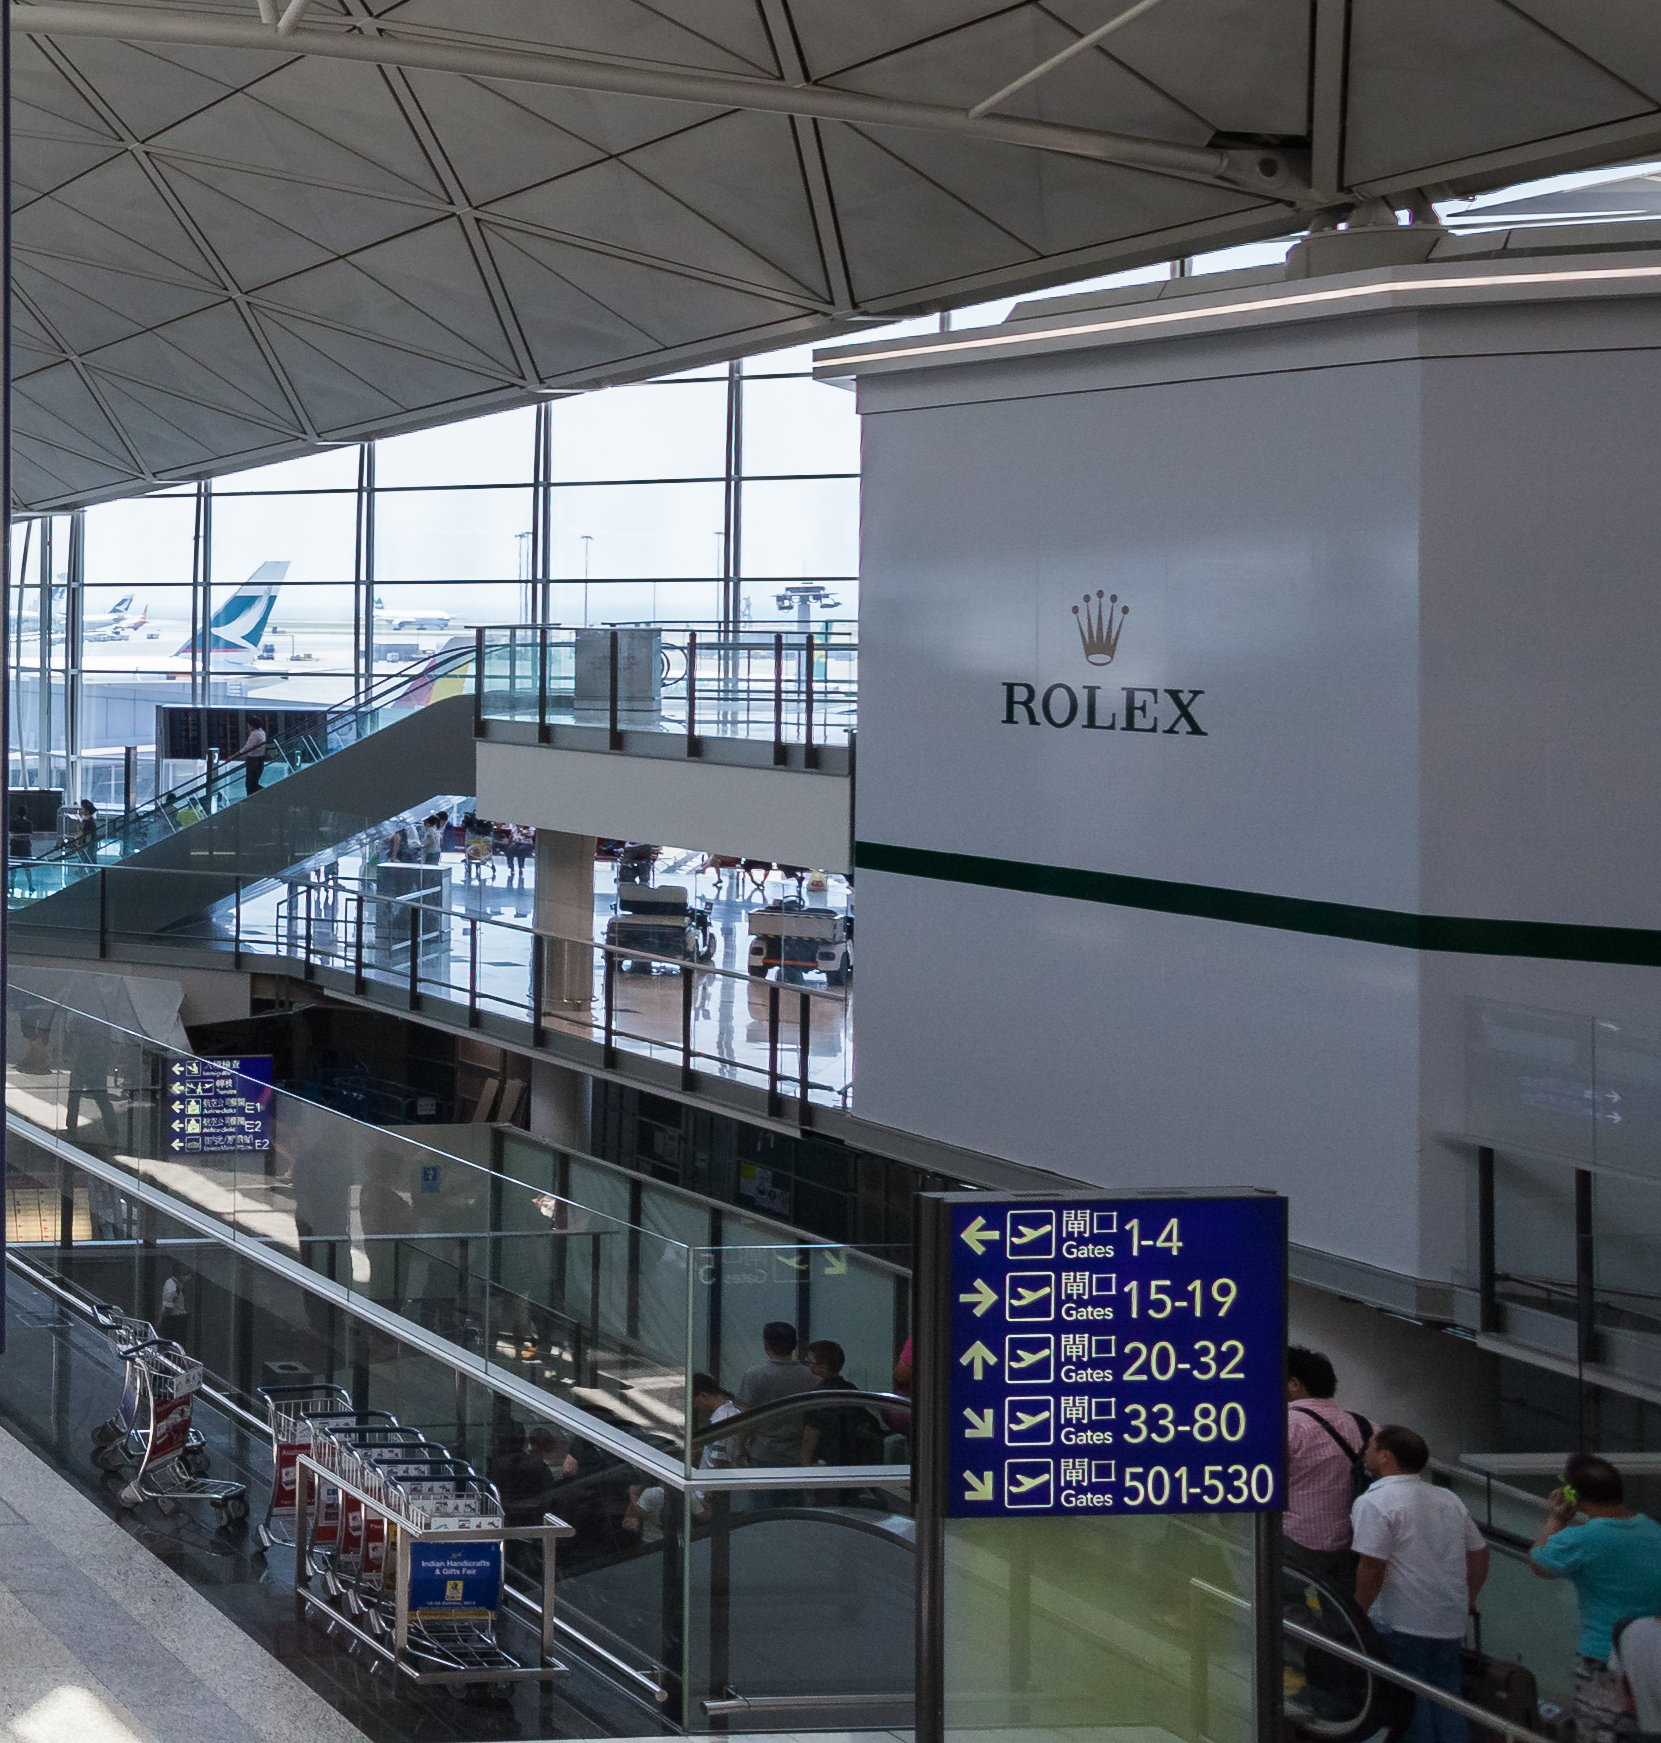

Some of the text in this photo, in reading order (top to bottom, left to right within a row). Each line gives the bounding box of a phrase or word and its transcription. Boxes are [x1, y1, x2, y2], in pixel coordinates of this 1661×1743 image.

[1001, 681, 1208, 736] ROLEX
[245, 1102, 261, 1113] E1
[245, 1121, 262, 1132] E2
[255, 1139, 270, 1150] E2
[1062, 1210, 1117, 1237] 閘口
[1063, 1218, 1183, 1258] Gates 1-4
[1061, 1272, 1116, 1300] 閘口
[1061, 1278, 1237, 1320] Gates 15-19
[1061, 1334, 1116, 1362] 閘口
[1061, 1340, 1245, 1382] Gates 20-32
[1061, 1396, 1116, 1424] 閘口
[1061, 1402, 1246, 1444] Gates 33-80
[1061, 1458, 1116, 1486] 閘口
[1061, 1464, 1274, 1507] Gates 501-530
[447, 1559, 490, 1567] Handicrafts
